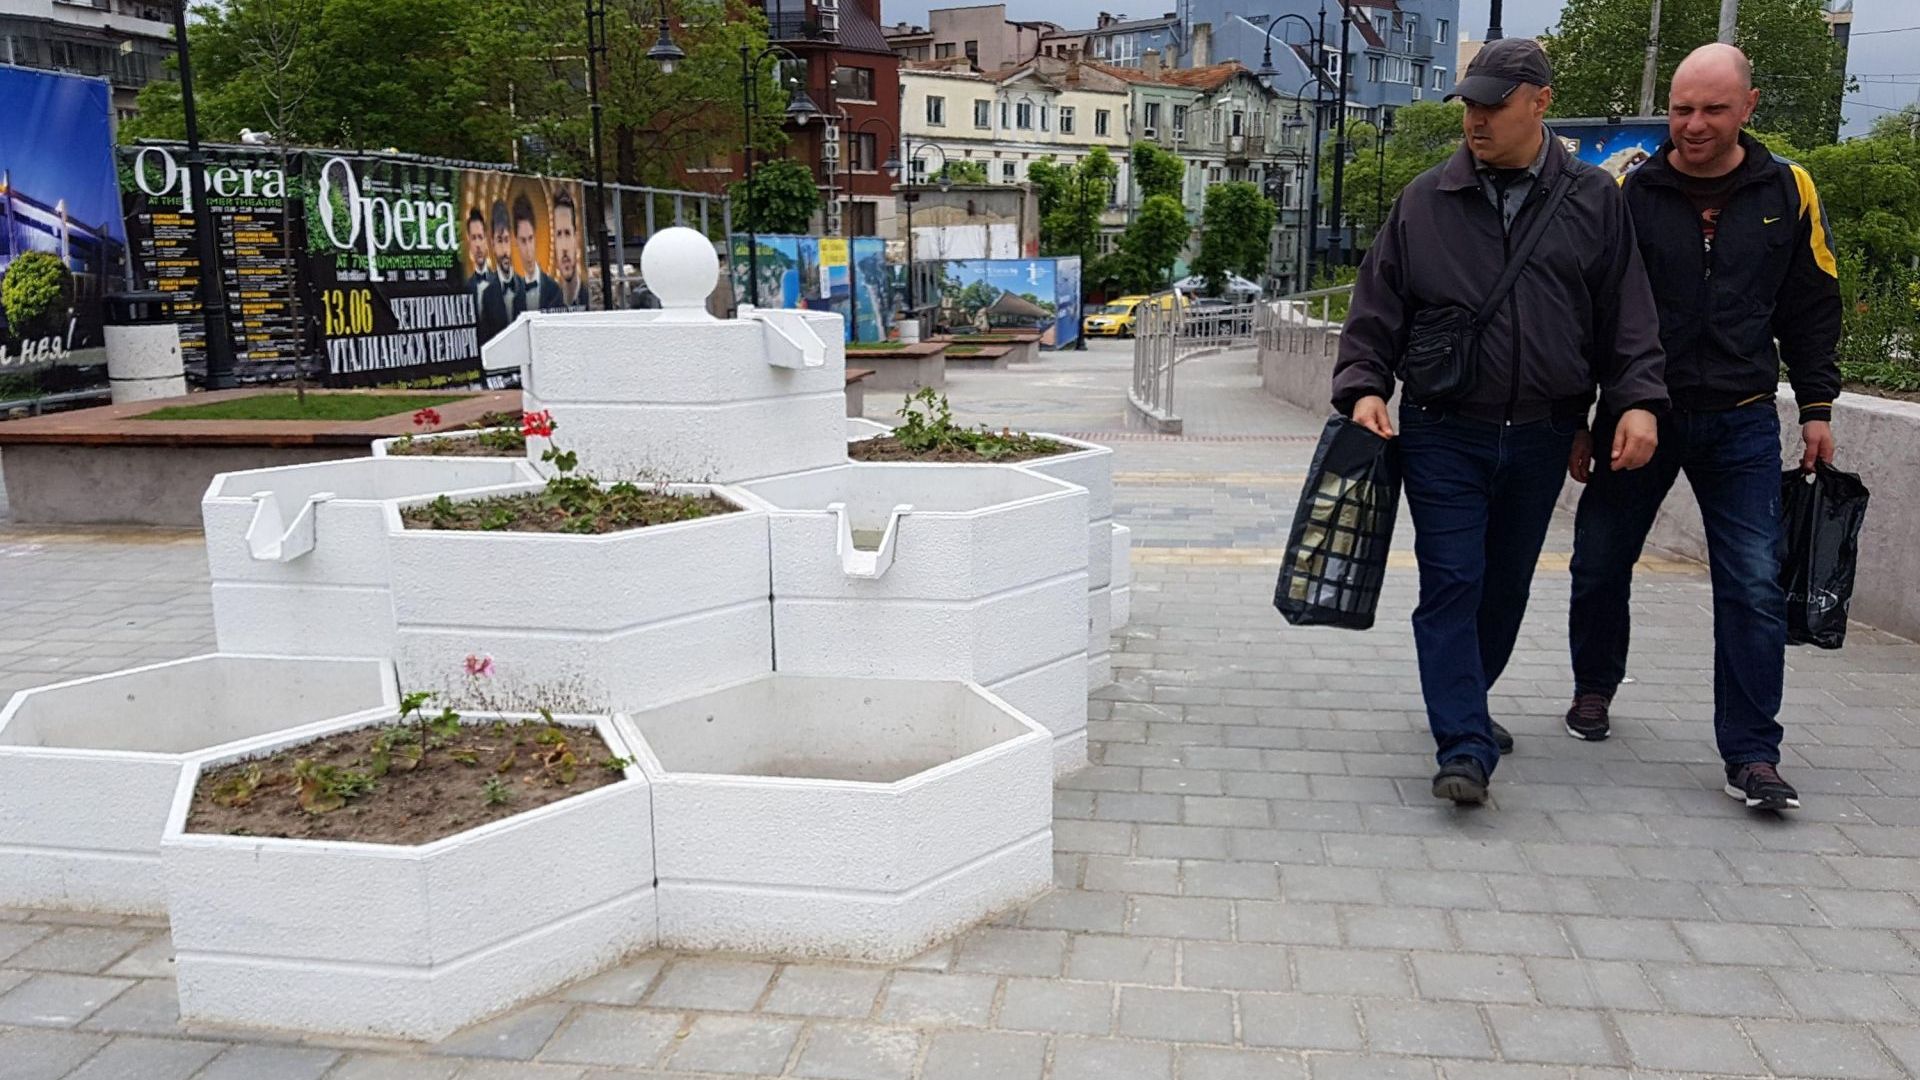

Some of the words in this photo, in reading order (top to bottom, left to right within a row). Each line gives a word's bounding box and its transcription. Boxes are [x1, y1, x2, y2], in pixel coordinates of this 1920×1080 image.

[134, 147, 285, 213] Opera
[319, 157, 459, 282] Opera
[321, 288, 373, 336] 13.06
[326, 334, 427, 374] ИТАЛИАНСКИ
[427, 327, 479, 363] ТЕНОРИ
